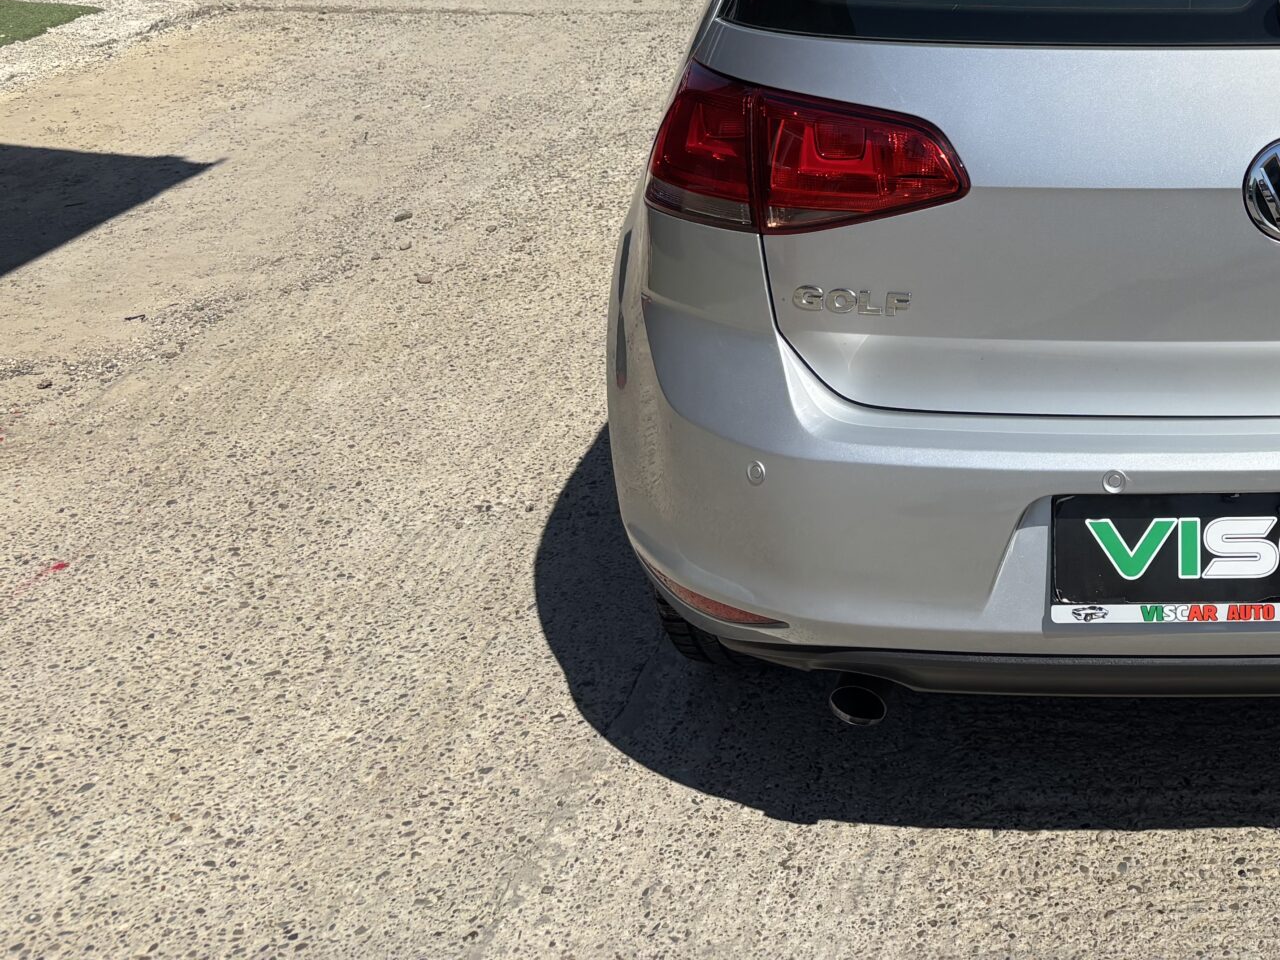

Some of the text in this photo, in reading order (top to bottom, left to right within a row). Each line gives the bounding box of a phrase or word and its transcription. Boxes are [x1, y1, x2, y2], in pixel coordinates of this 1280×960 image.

[792, 284, 912, 316] GOLF
[1140, 604, 1218, 622] VISCAR
[1226, 603, 1275, 621] AUTO
